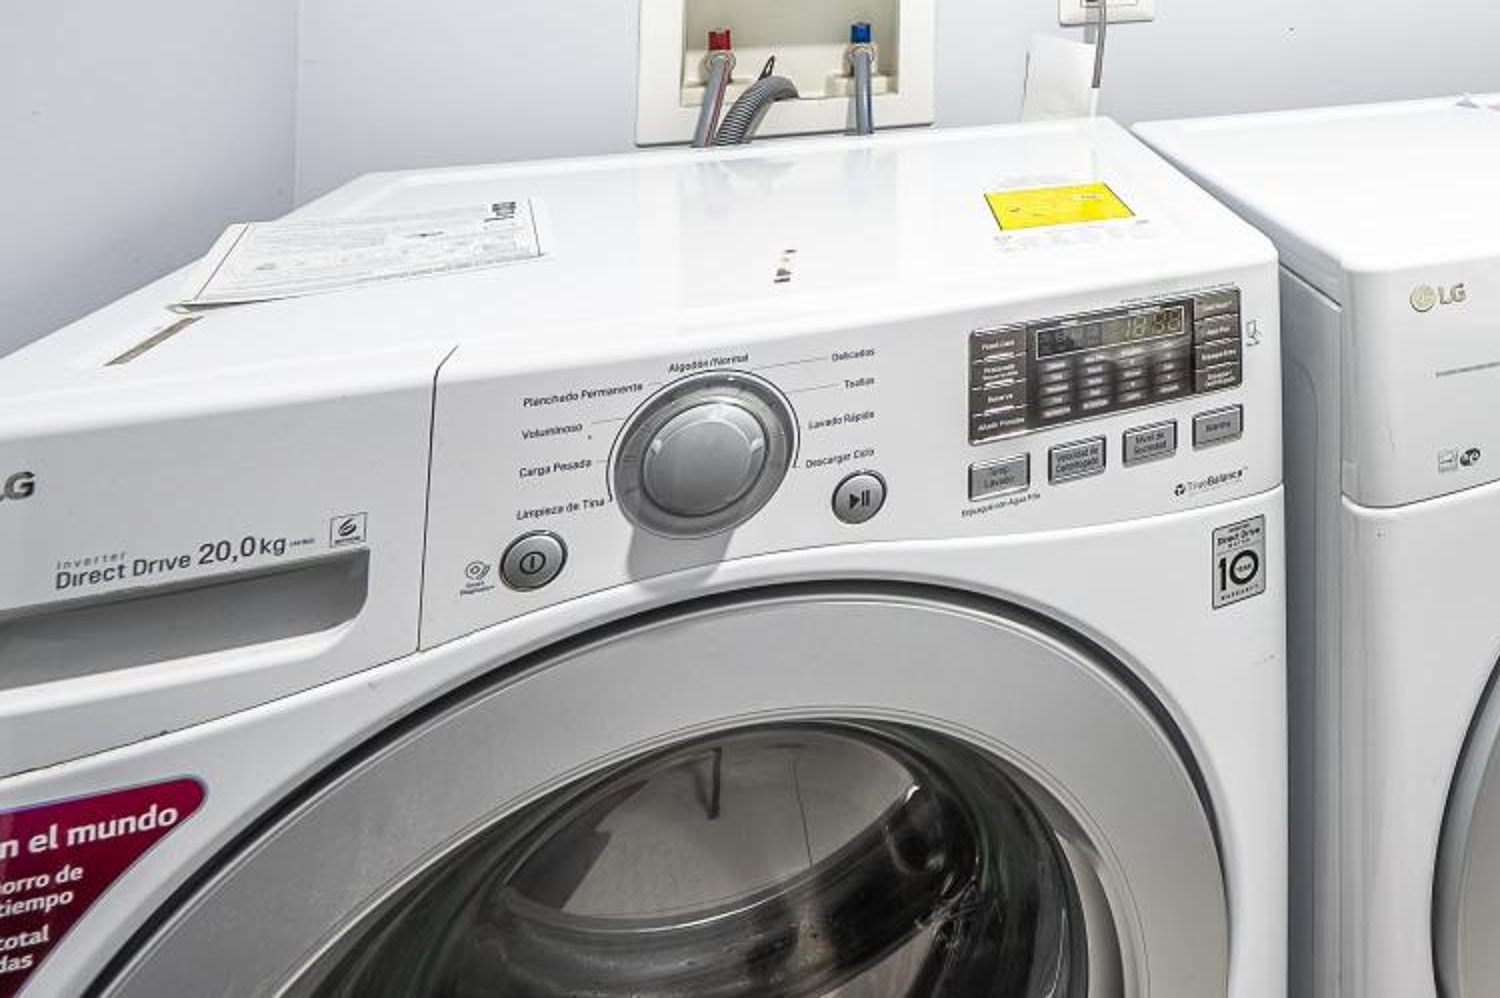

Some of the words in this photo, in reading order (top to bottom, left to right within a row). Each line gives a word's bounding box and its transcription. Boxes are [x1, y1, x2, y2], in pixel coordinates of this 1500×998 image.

[1438, 283, 1467, 305] LG
[523, 390, 579, 407] Planchado
[581, 383, 643, 399] Permanente
[521, 423, 583, 440] Voluminoso
[519, 465, 551, 479] Carga
[552, 459, 592, 473] Pesada
[0, 471, 35, 502] G
[516, 504, 563, 521] Limpieza
[565, 502, 579, 514] de
[582, 498, 605, 511] Tina
[55, 563, 127, 590] Direct
[133, 554, 191, 578] Drive
[1218, 549, 1260, 591] 10
[28, 823, 59, 854] el
[66, 803, 179, 847] mundo
[0, 873, 50, 896] orro
[54, 863, 84, 884] de
